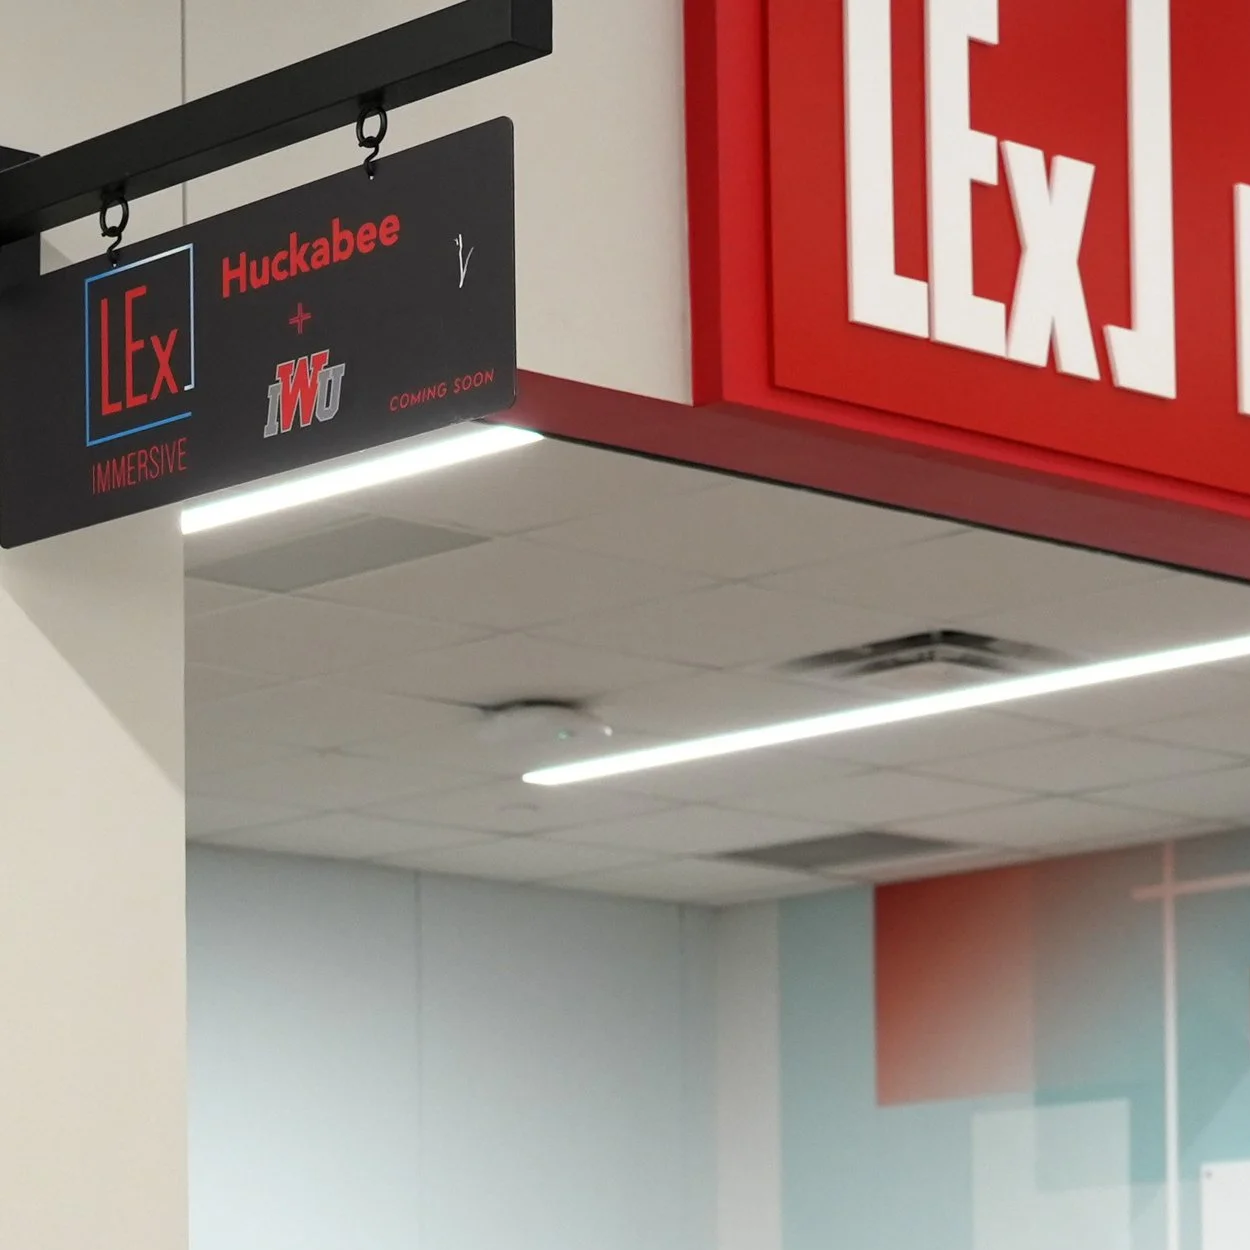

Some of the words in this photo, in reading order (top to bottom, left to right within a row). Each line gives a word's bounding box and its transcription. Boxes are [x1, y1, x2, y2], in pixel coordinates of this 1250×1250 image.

[221, 214, 401, 298] Huckabee
[100, 285, 180, 415] LEx
[389, 383, 448, 412] COMING
[453, 370, 495, 394] SOON
[263, 349, 346, 438] IWU
[92, 437, 188, 494] IMMERSIVE
